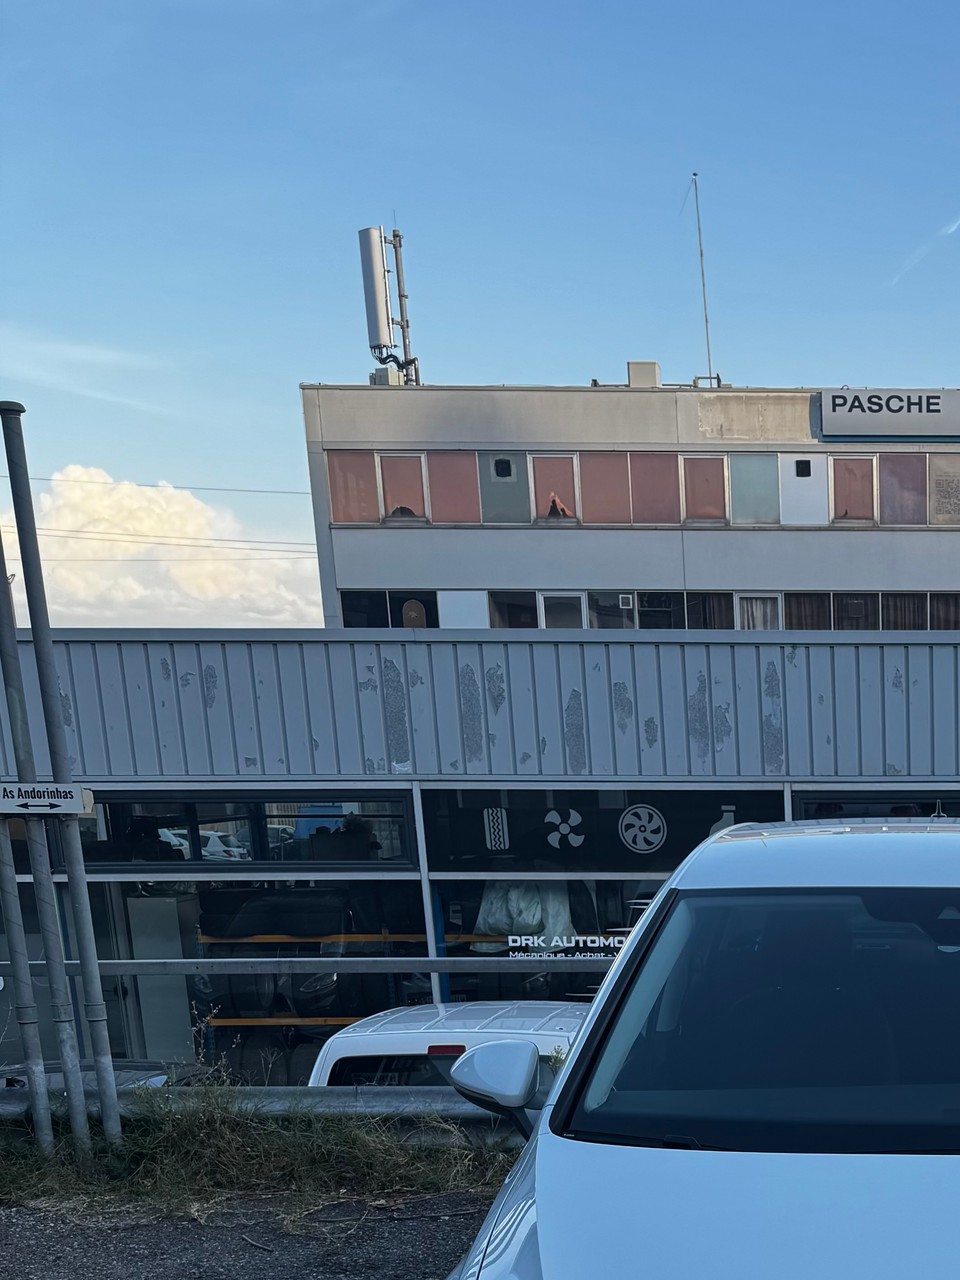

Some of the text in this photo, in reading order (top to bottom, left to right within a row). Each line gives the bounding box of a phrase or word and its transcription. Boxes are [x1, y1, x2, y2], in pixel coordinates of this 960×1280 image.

[831, 394, 942, 414] PASCHE
[2, 787, 74, 800] As Andorinhas
[507, 935, 546, 947] DRK
